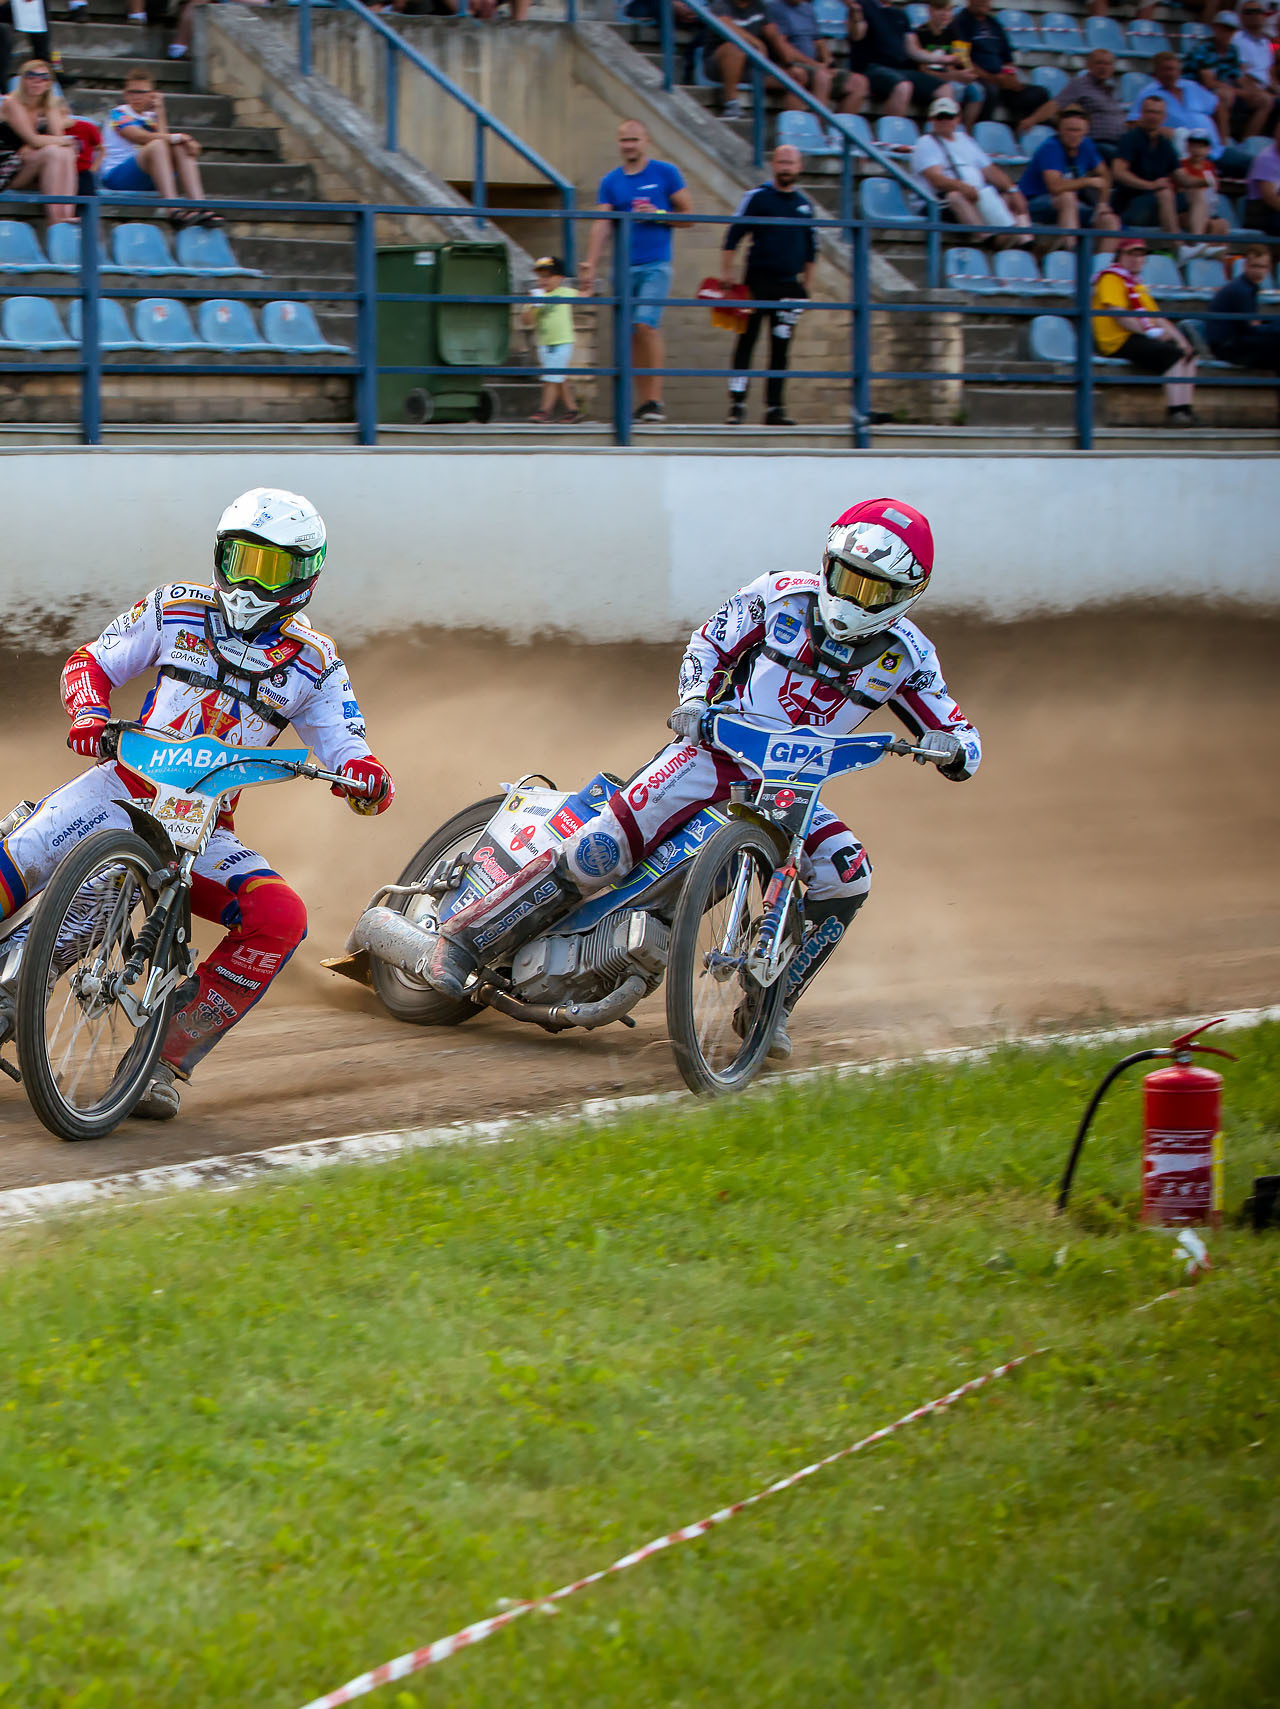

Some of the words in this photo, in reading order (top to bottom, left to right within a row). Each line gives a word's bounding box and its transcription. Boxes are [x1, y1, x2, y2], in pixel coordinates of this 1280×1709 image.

[770, 743, 826, 766] GPA
[77, 811, 109, 838] AIRPORT
[231, 944, 282, 970] LTE
[215, 965, 261, 990] speedway
[208, 989, 237, 1019] TEXIM
